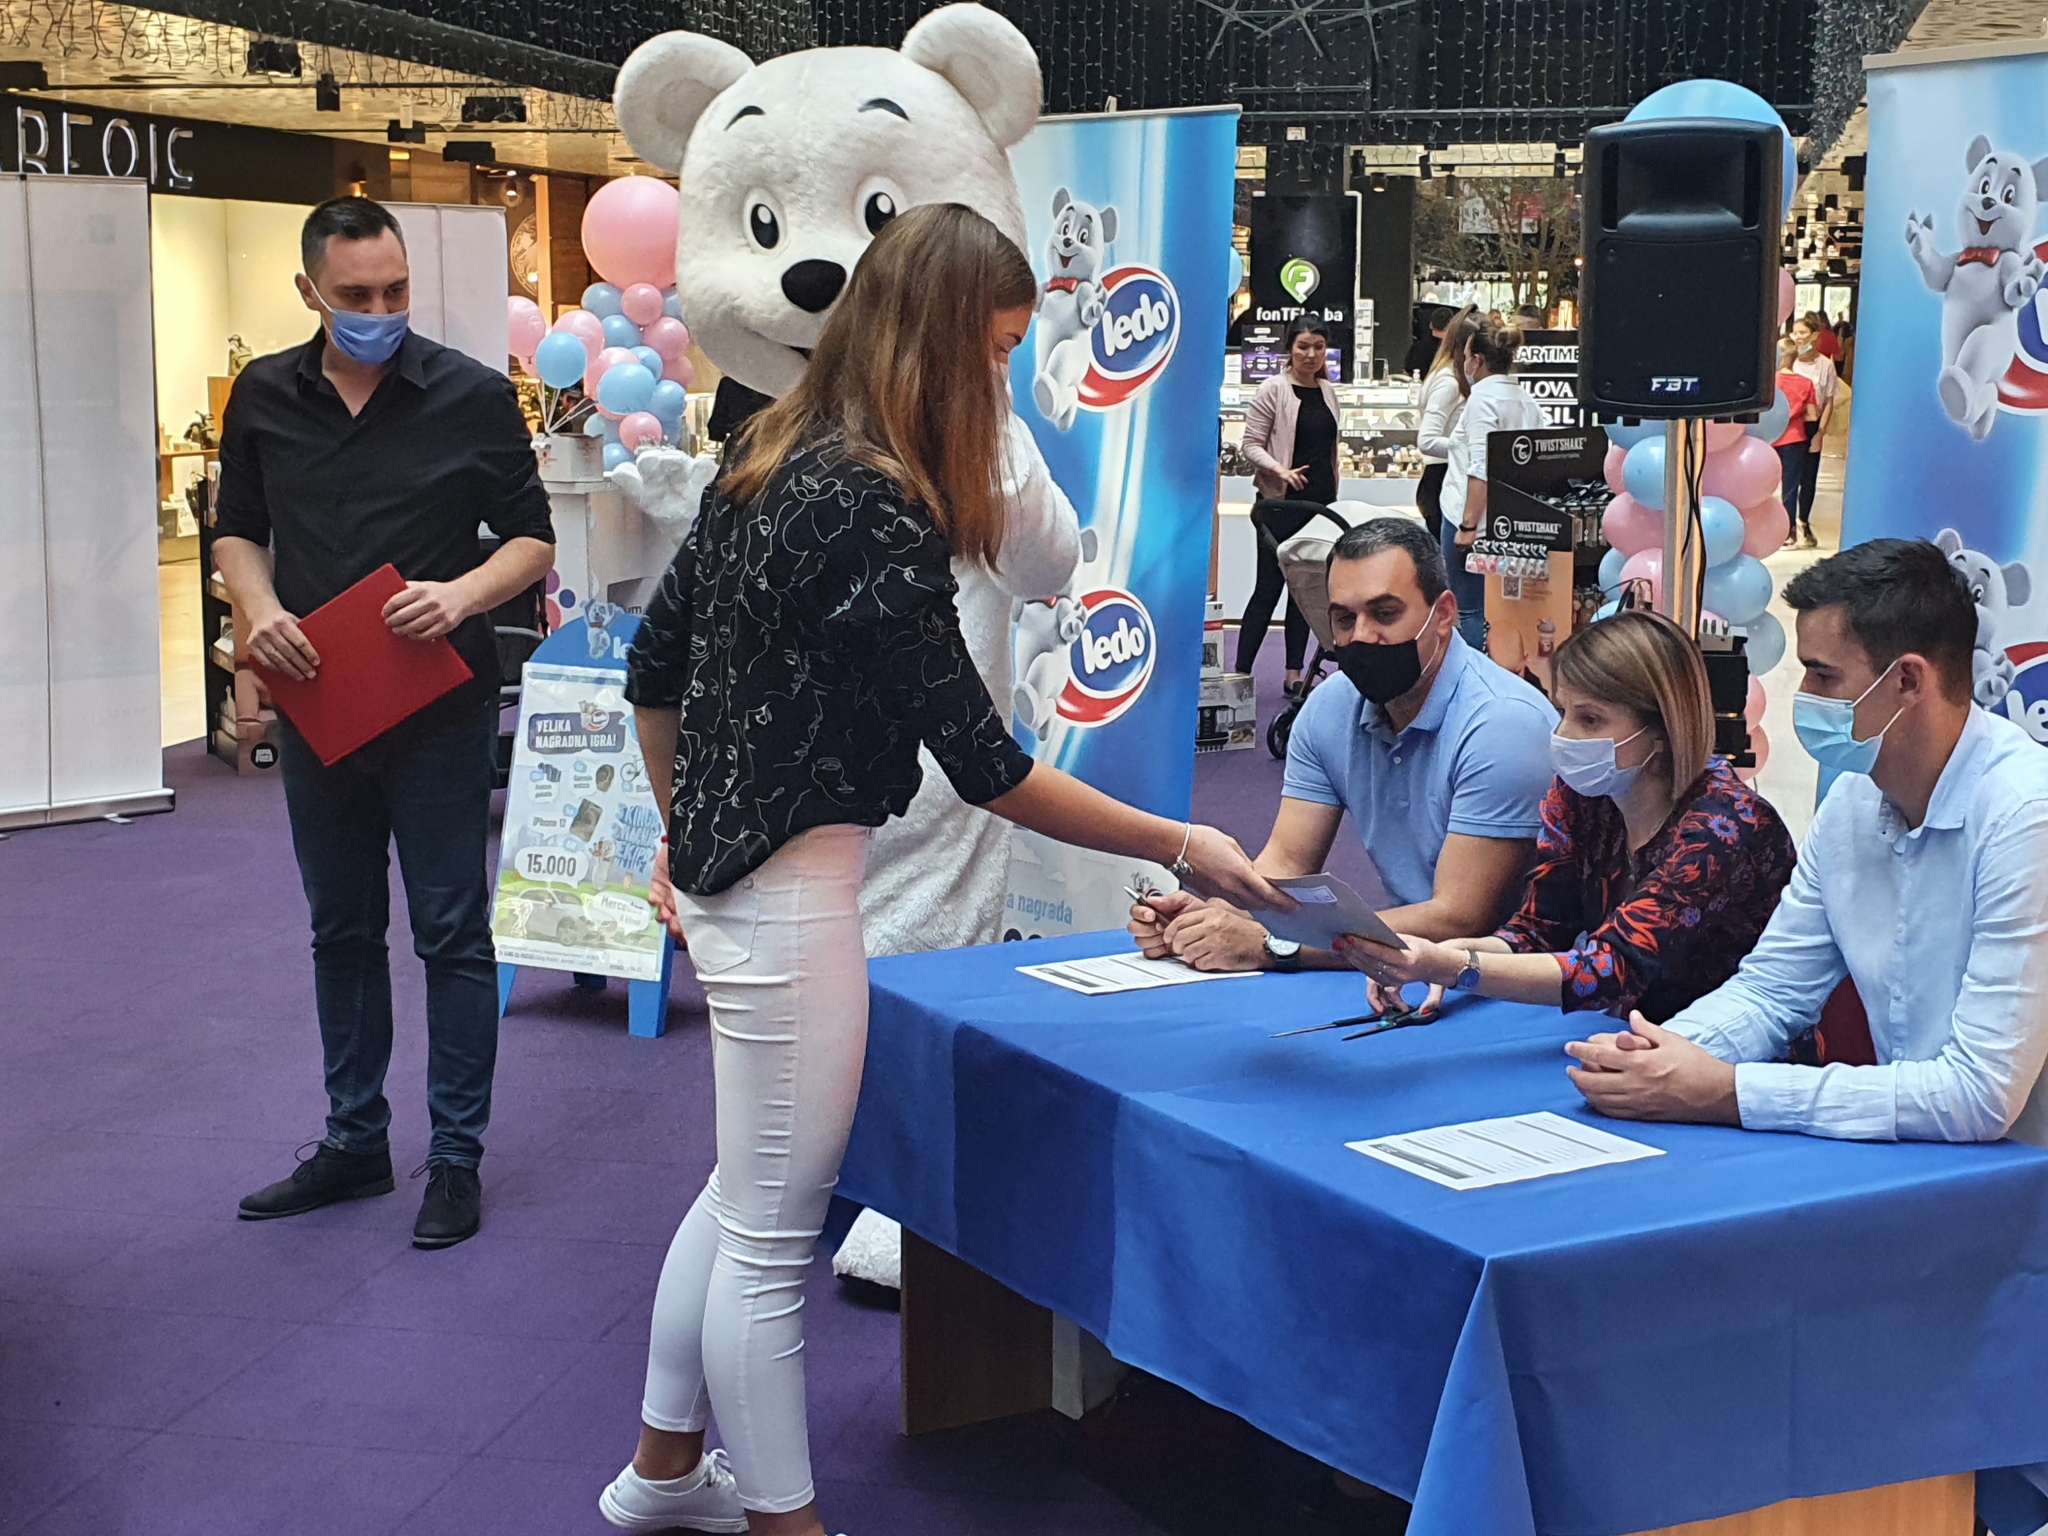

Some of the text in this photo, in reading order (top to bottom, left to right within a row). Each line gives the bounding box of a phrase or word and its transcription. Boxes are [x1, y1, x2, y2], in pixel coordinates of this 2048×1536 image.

[1103, 293, 1170, 356] ledo
[1651, 377, 1699, 392] FBT
[1341, 430, 1384, 438] DIESEL
[1081, 617, 1145, 675] ledo
[536, 720, 571, 733] VELIKA
[535, 734, 616, 748] NAGRADNA IGRA!
[527, 853, 577, 877] 15.000
[1018, 893, 1073, 925] nagrada
